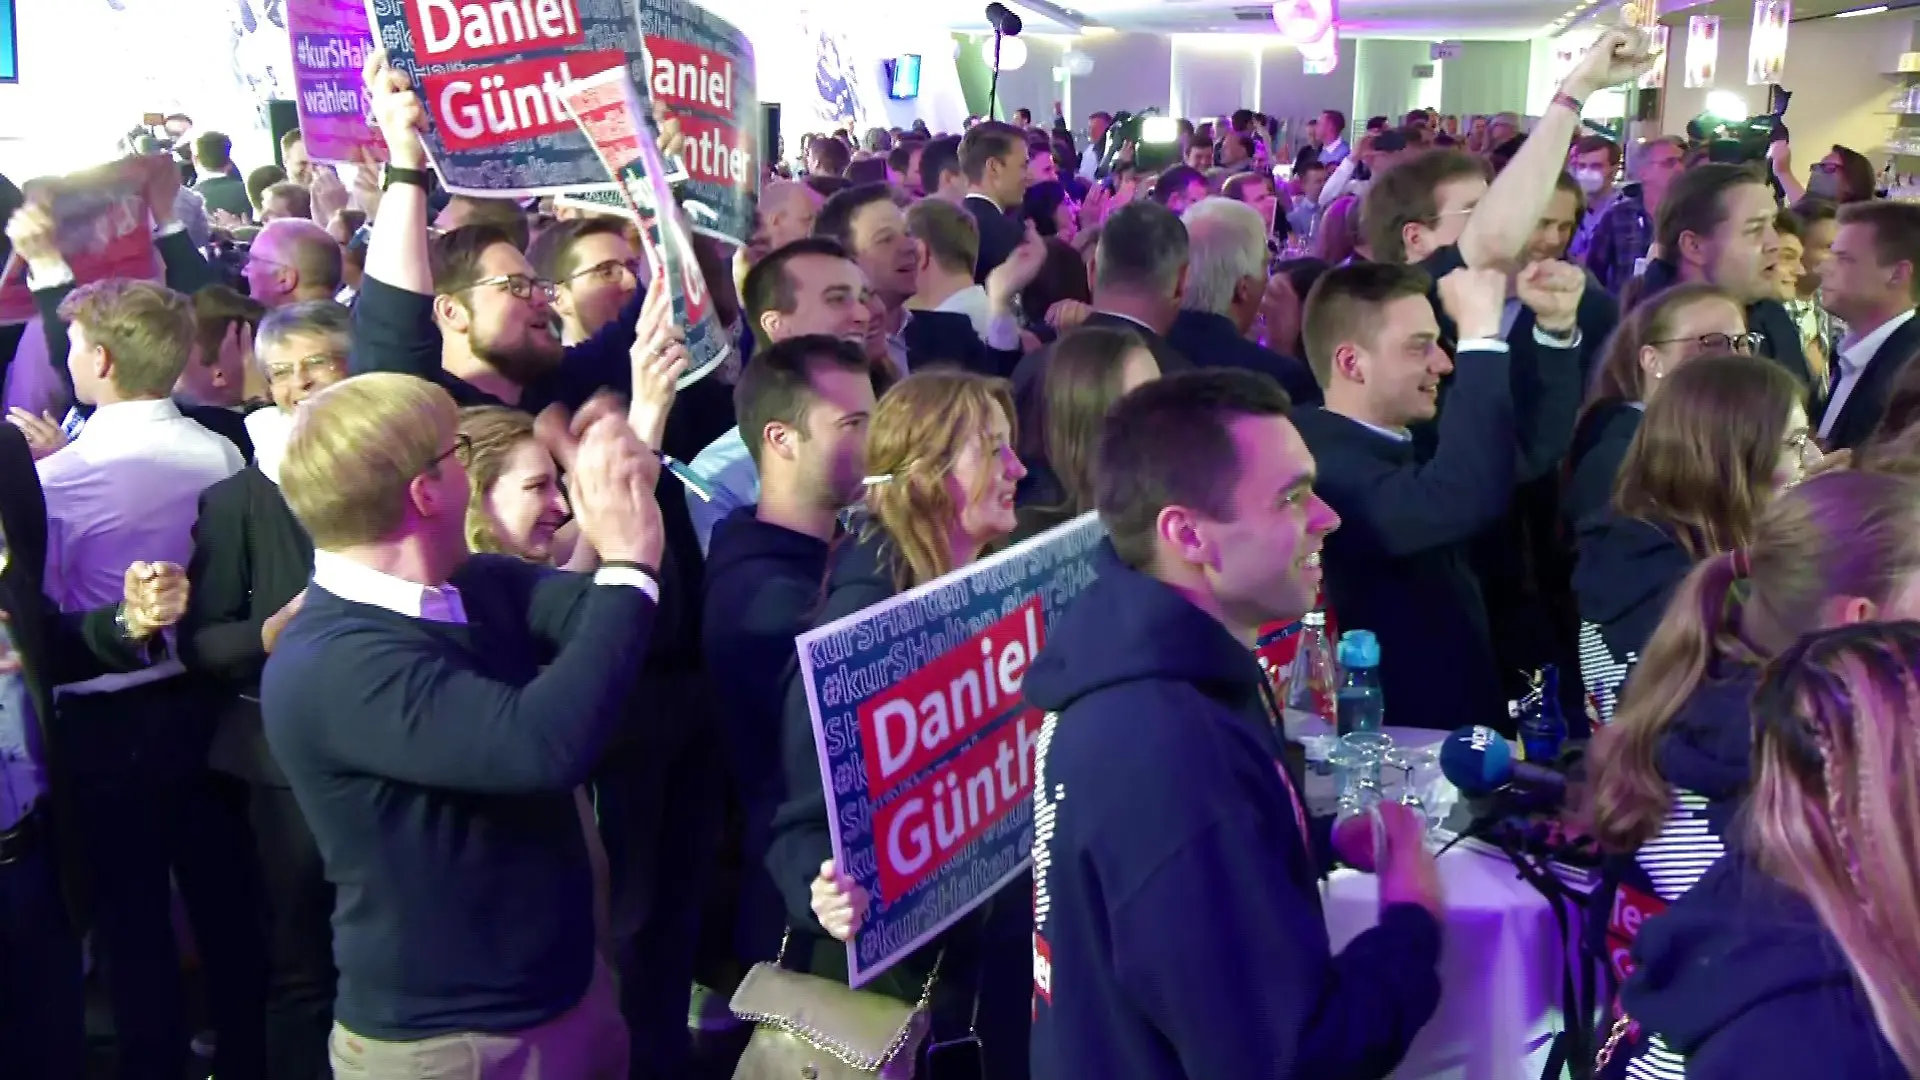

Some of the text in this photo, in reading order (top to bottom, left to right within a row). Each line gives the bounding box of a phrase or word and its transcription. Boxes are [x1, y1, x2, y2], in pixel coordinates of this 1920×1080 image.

[303, 82, 359, 114] wählen
[651, 55, 734, 111] aniel
[684, 127, 751, 184] nther
[872, 606, 1038, 781] Daniel
